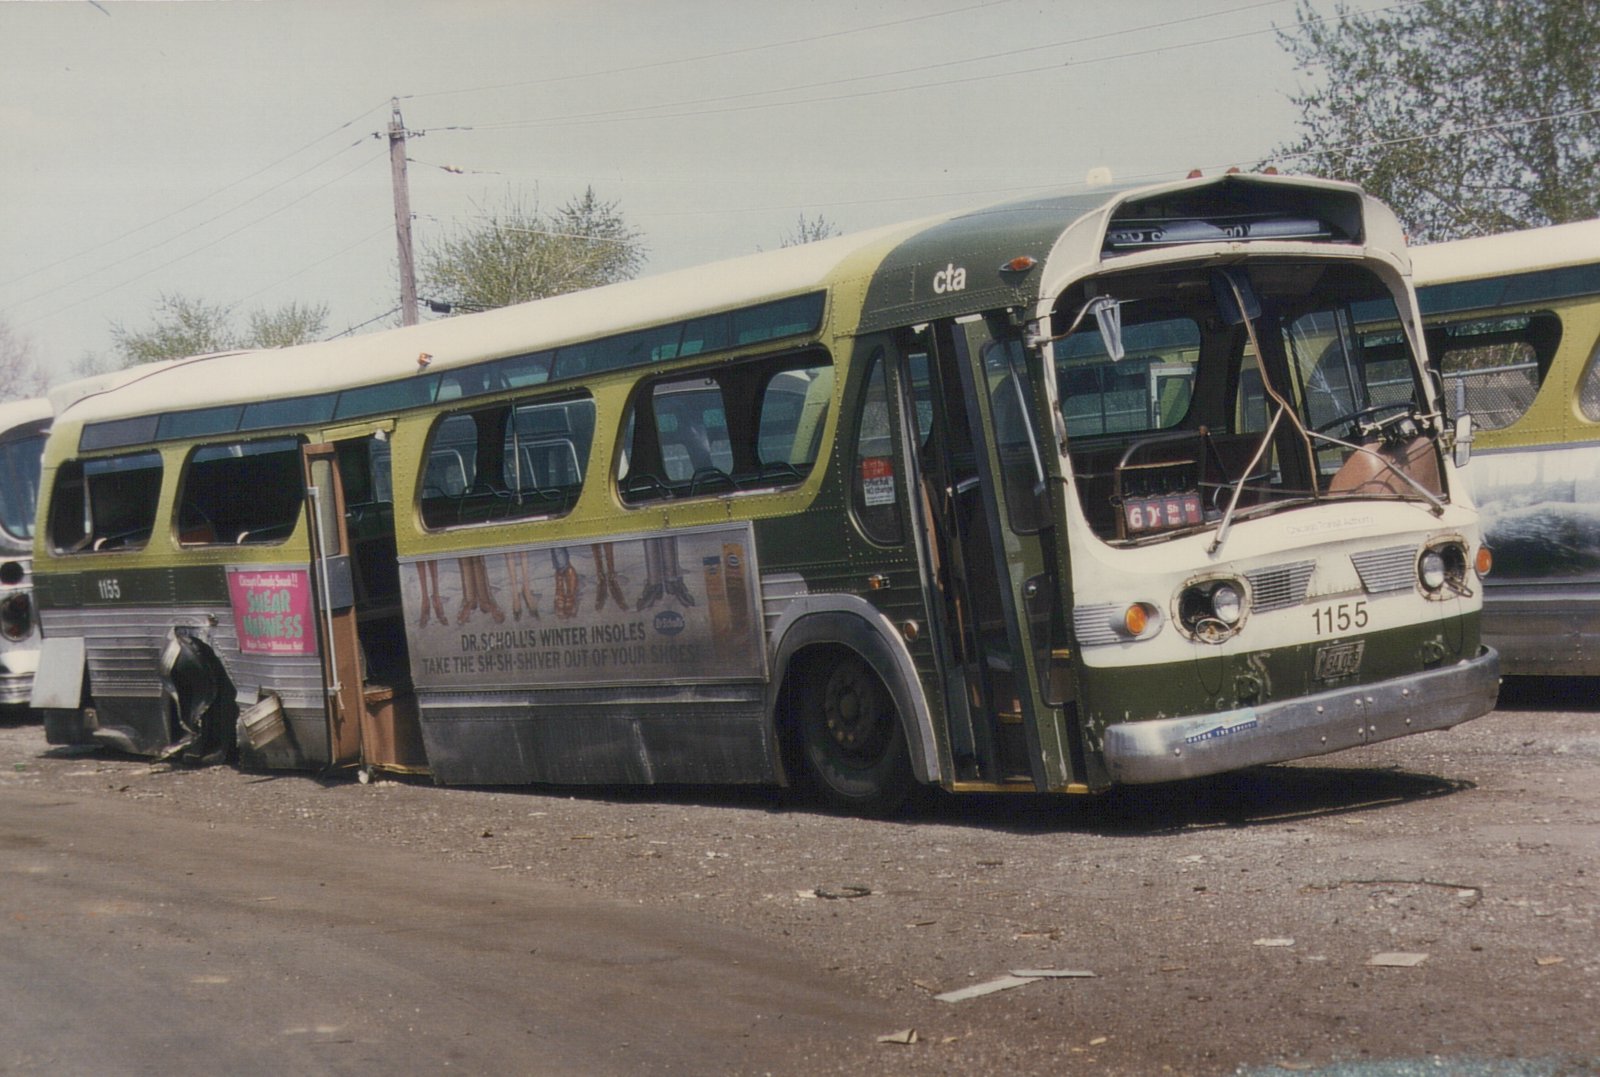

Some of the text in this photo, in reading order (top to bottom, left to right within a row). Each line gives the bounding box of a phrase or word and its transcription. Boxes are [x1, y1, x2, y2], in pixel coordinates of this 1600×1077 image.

[933, 263, 966, 294] cta
[98, 579, 121, 600] 1155
[1312, 601, 1368, 635] 1155
[540, 626, 588, 647] WINTER
[592, 622, 647, 644] INSOLES
[422, 657, 451, 675] TAKE
[453, 655, 475, 673] THE
[564, 649, 589, 668] OUT
[592, 648, 607, 666] OF
[608, 646, 647, 665] YOUR
